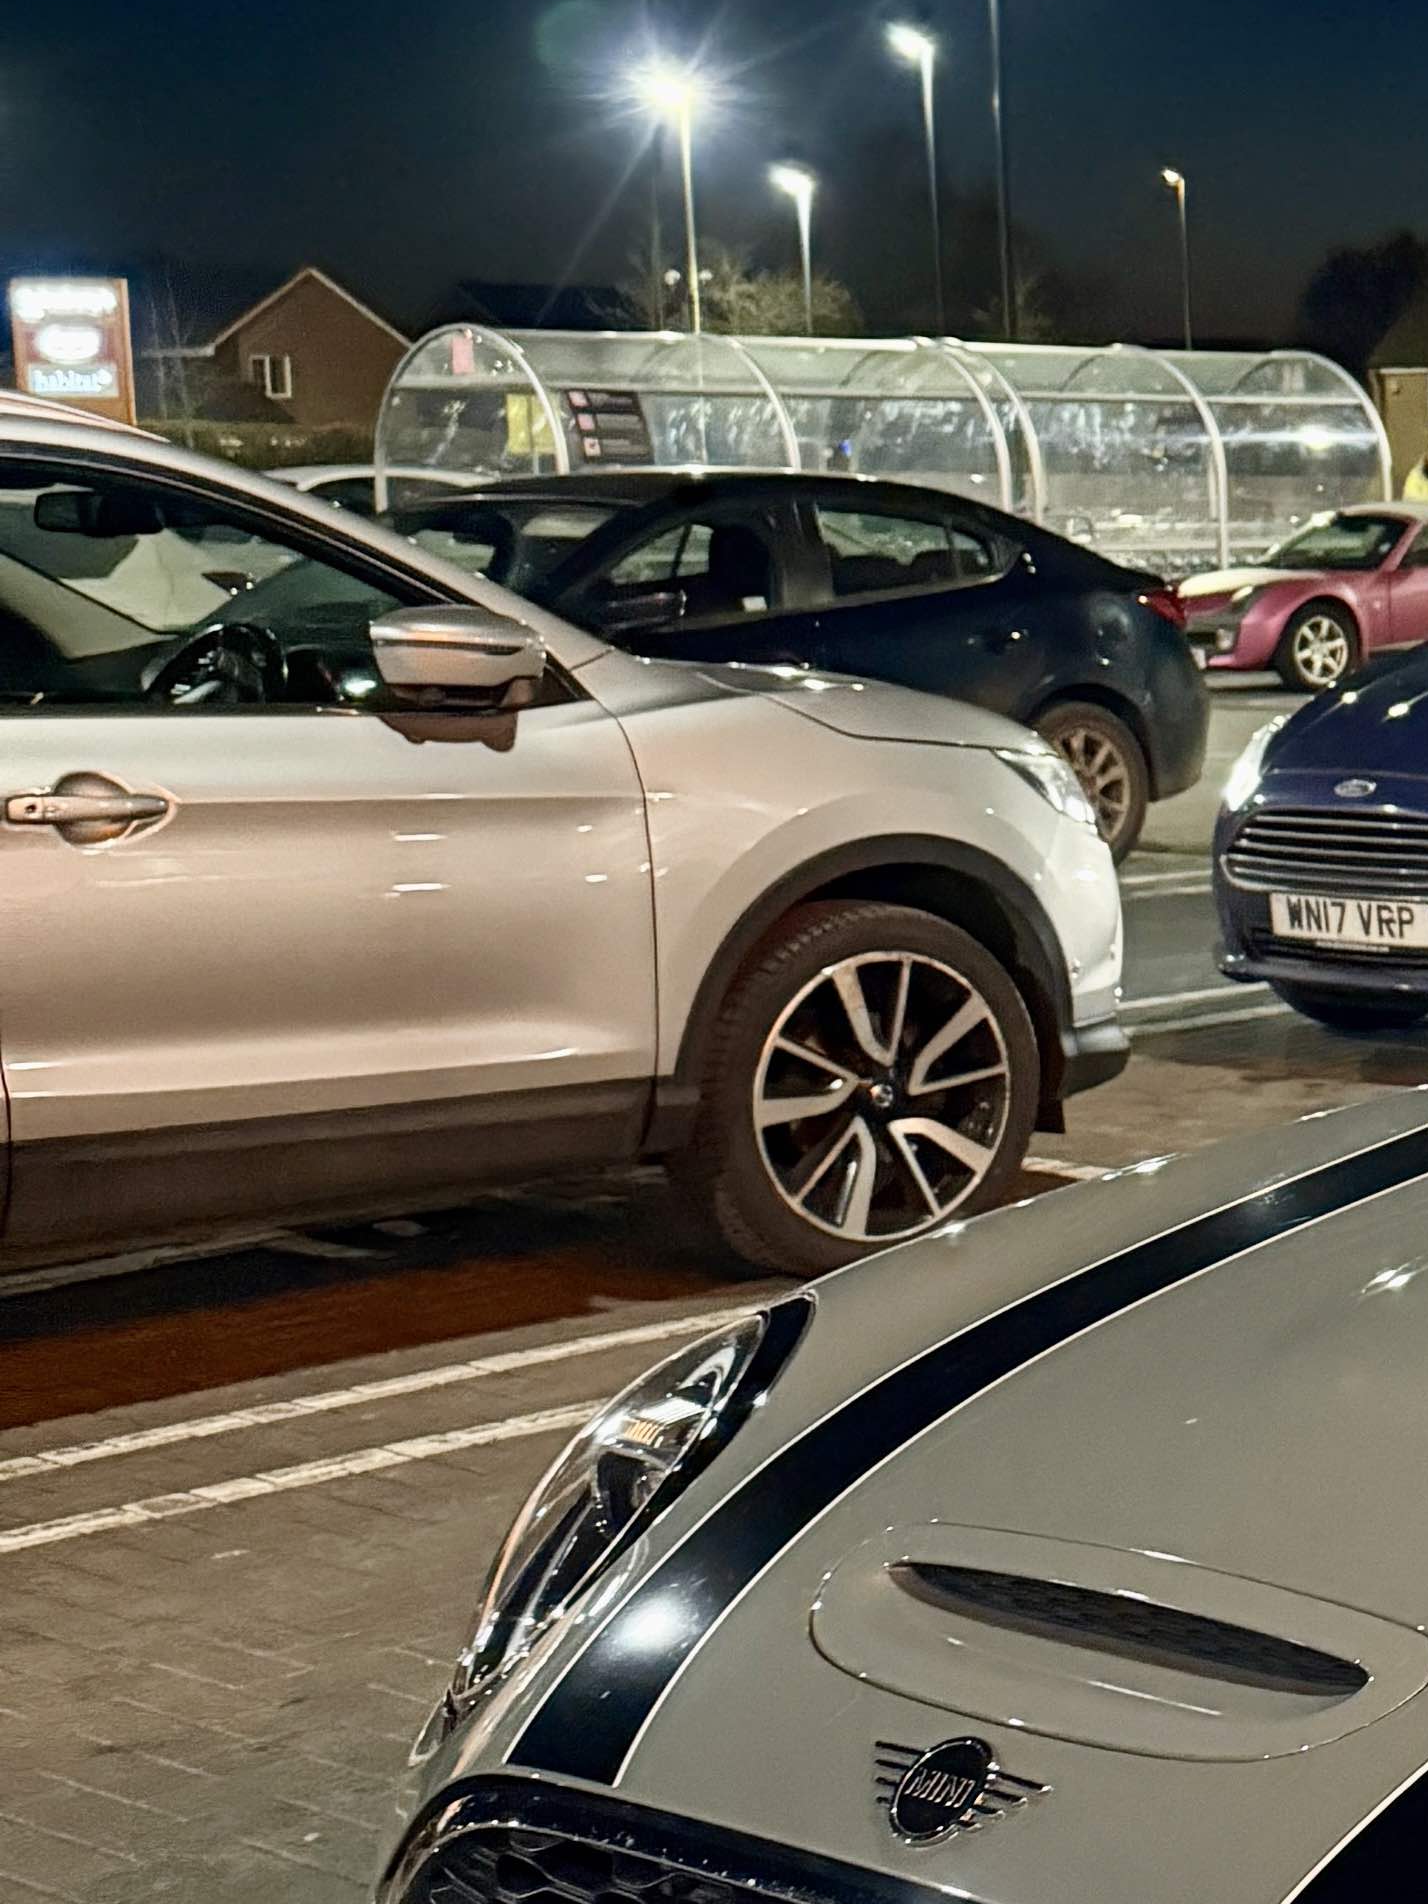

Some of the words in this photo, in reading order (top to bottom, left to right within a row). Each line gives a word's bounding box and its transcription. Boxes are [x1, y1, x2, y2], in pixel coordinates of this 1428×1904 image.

[1286, 895, 1346, 934] WN17
[1357, 902, 1415, 939] VRP
[903, 1767, 976, 1808] MINI
